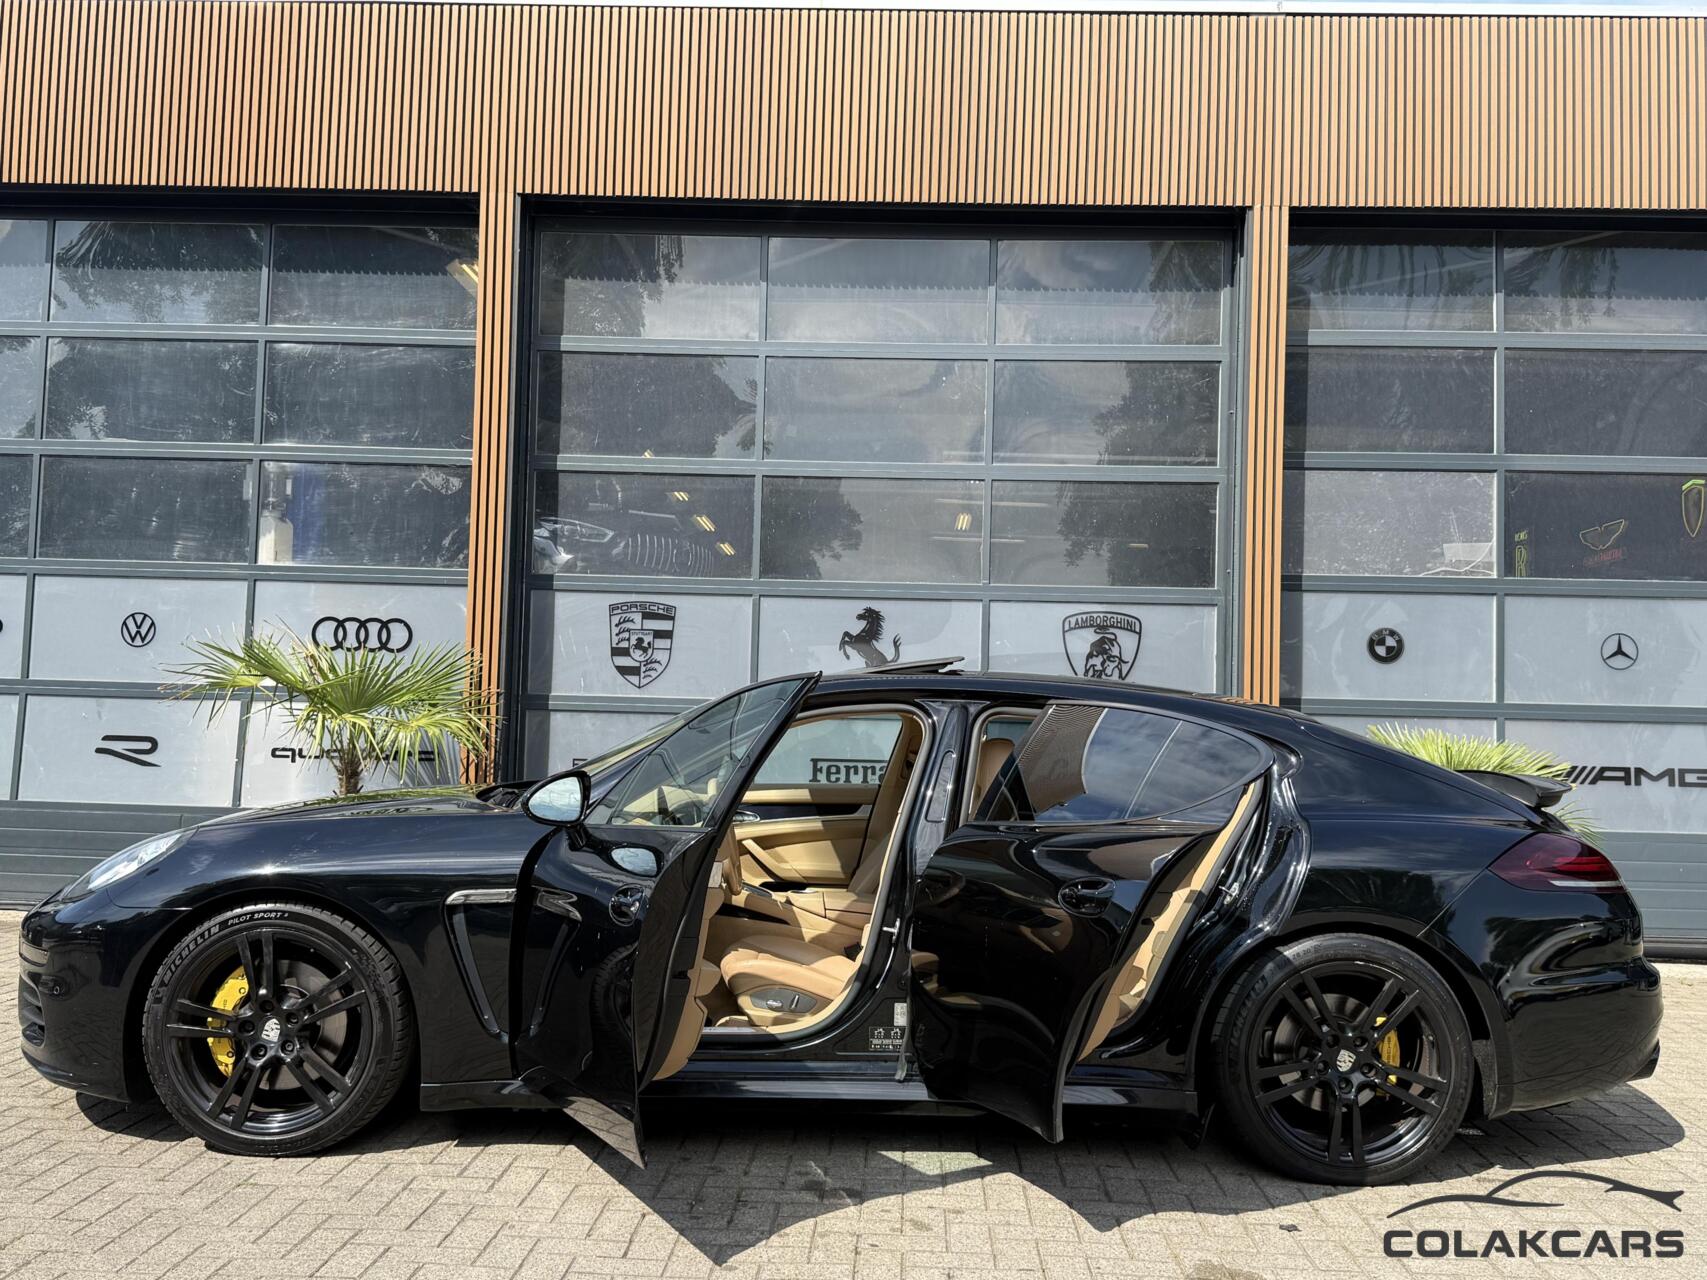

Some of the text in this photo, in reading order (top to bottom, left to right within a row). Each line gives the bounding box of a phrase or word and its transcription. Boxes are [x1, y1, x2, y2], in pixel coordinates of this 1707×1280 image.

[611, 603, 674, 614] PORSCHE
[1068, 615, 1137, 631] LAMBORGHINI
[163, 924, 220, 985] MICHELIN
[228, 914, 251, 926] PILOT
